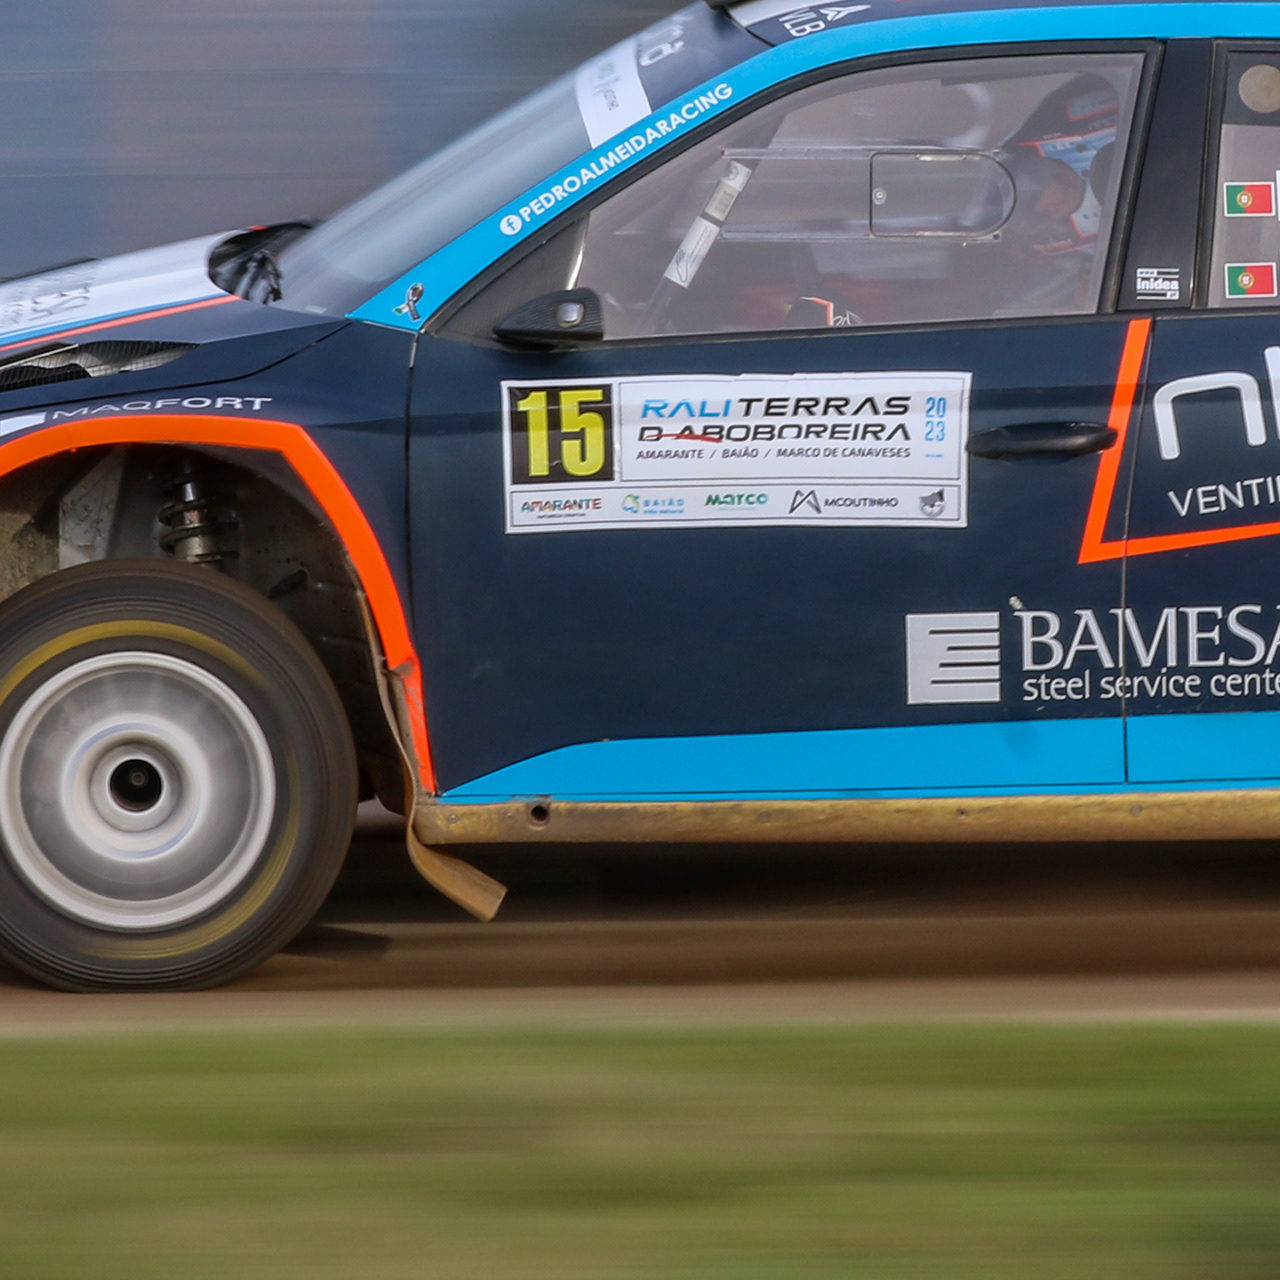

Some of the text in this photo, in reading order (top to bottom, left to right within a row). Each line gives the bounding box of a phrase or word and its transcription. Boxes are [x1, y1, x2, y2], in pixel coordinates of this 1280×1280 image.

[518, 83, 733, 222] PEDROALMEIDARACING
[1136, 277, 1179, 290] inidea
[52, 397, 273, 420] MAQFORT
[640, 396, 912, 419] RALI TERRAS
[925, 396, 947, 419] 20
[516, 388, 606, 477] 15
[925, 421, 946, 442] 23
[636, 449, 705, 460] AMARANTE
[722, 447, 759, 459] BAIÃO
[776, 448, 820, 458] MARCO
[822, 448, 838, 458] DE
[841, 447, 912, 458] CANAVESES
[521, 498, 603, 513] AMARANTE
[824, 497, 899, 508] MCOUTINHO
[1022, 669, 1090, 702] steel
[1100, 667, 1201, 699] service
